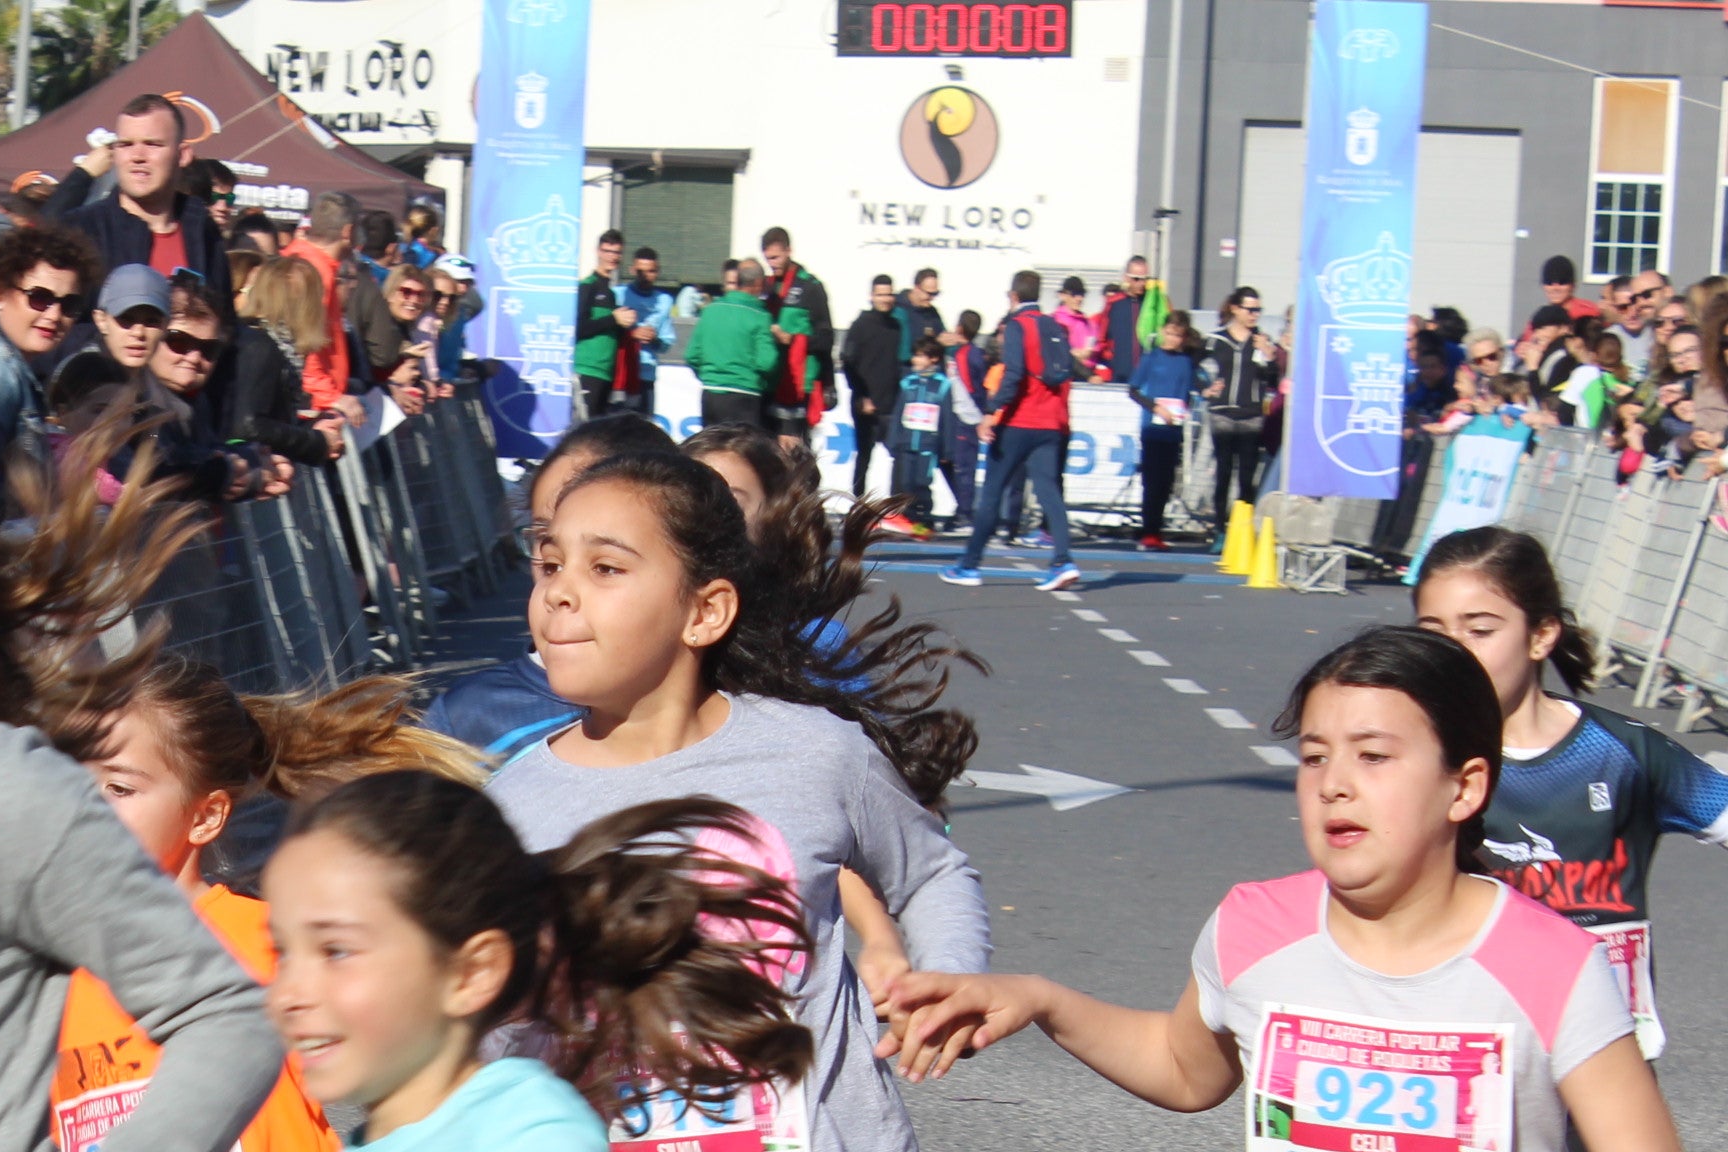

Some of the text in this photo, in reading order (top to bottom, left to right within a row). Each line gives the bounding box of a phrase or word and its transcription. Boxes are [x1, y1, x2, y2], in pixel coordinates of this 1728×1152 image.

[266, 46, 433, 97] NEW LORO
[860, 203, 1033, 232] NEW LORO
[1322, 1022, 1387, 1047] CARRERA
[1388, 1032, 1461, 1053] POPULAR
[1296, 1039, 1453, 1071] CIUDAD DE ROQUETAS
[81, 1096, 120, 1122] CARRERA
[1314, 1066, 1439, 1130] 923
